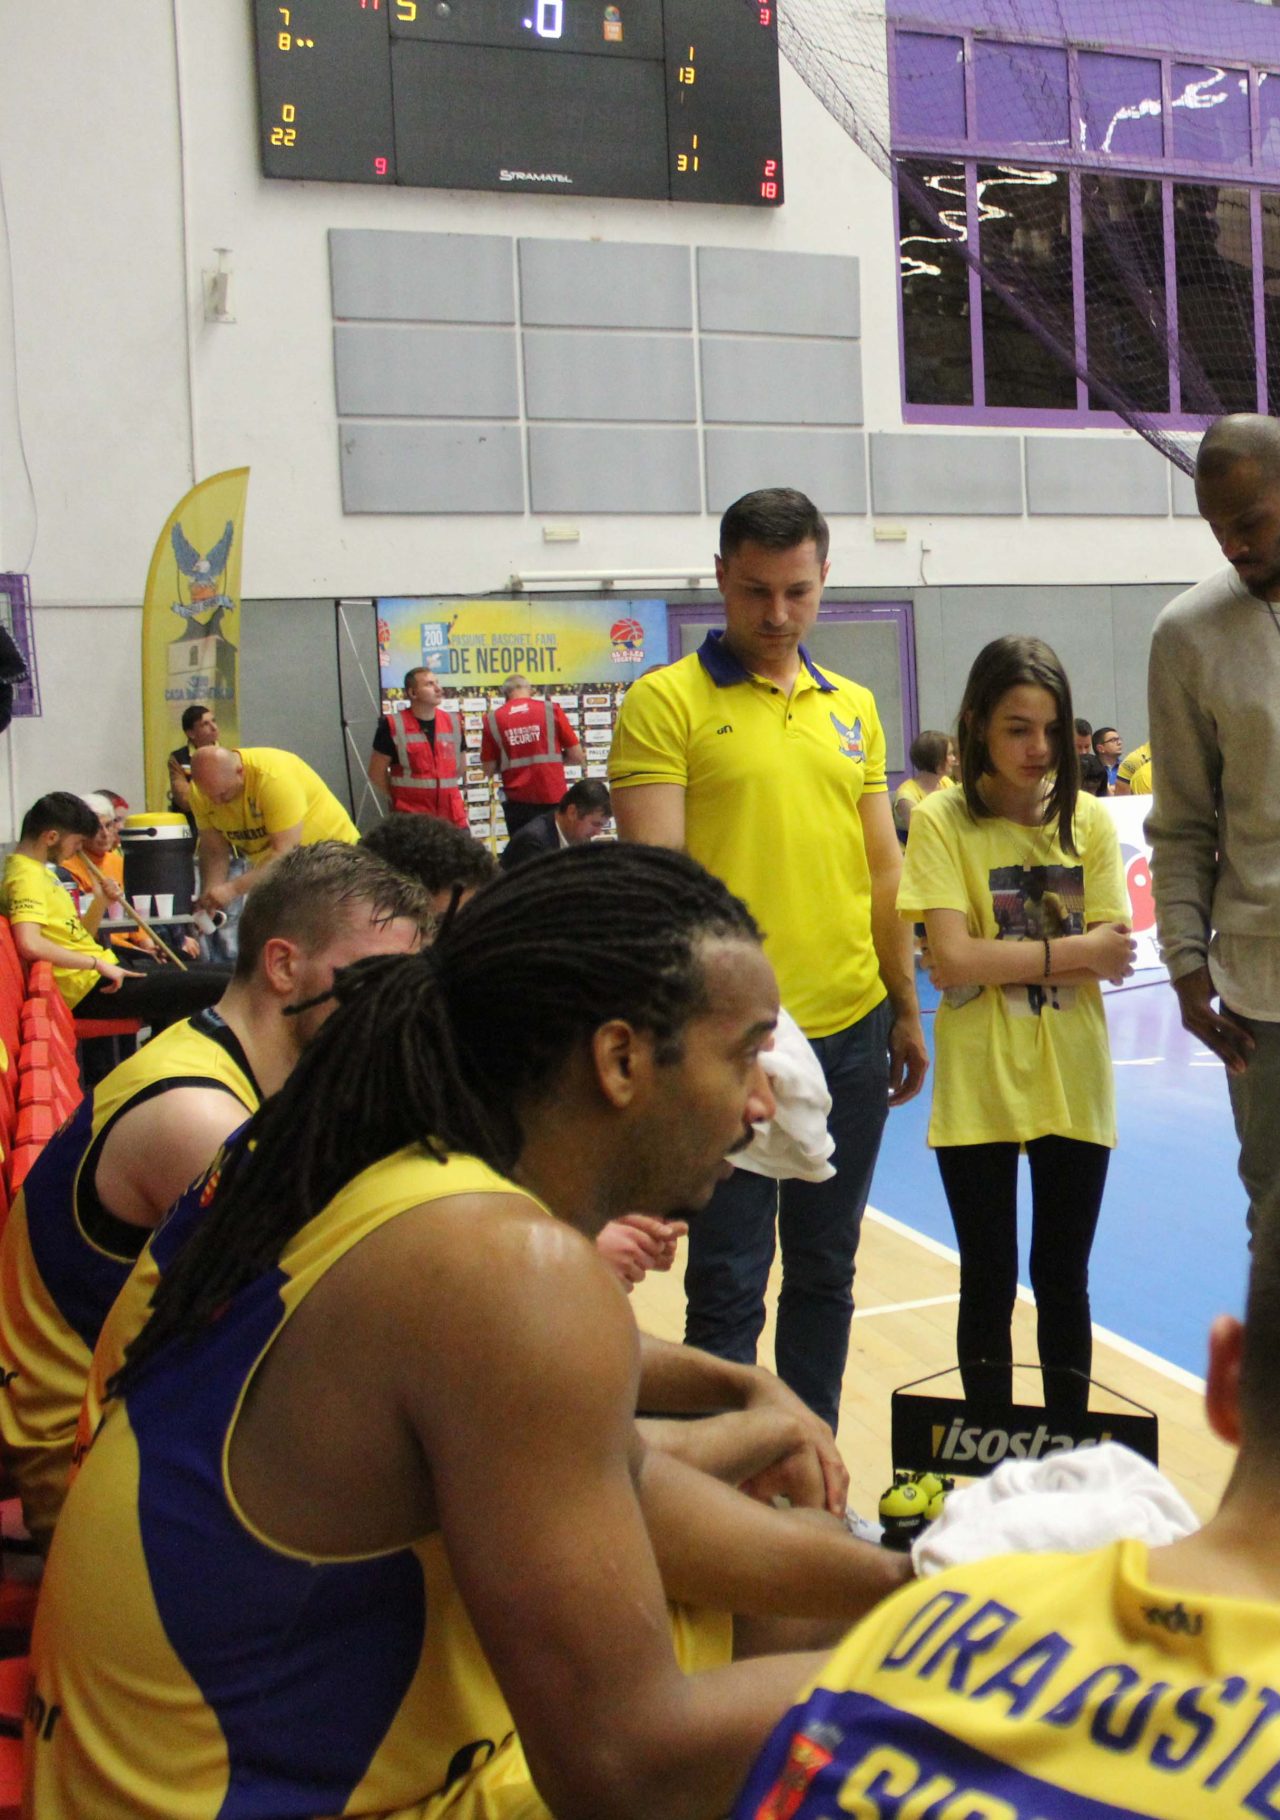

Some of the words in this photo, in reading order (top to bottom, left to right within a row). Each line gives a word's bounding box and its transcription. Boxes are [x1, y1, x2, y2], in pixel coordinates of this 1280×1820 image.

[278, 8, 290, 26] 7
[678, 66, 695, 85] 13
[282, 104, 295, 122] 0
[270, 127, 297, 147] 22
[374, 157, 387, 175] 9
[676, 154, 699, 172] 31
[764, 159, 777, 177] 2
[761, 181, 778, 199] 18
[424, 631, 443, 647] 200
[450, 648, 471, 674] DE
[476, 646, 561, 674] NEOPRIT.
[507, 731, 541, 747] ECURITY
